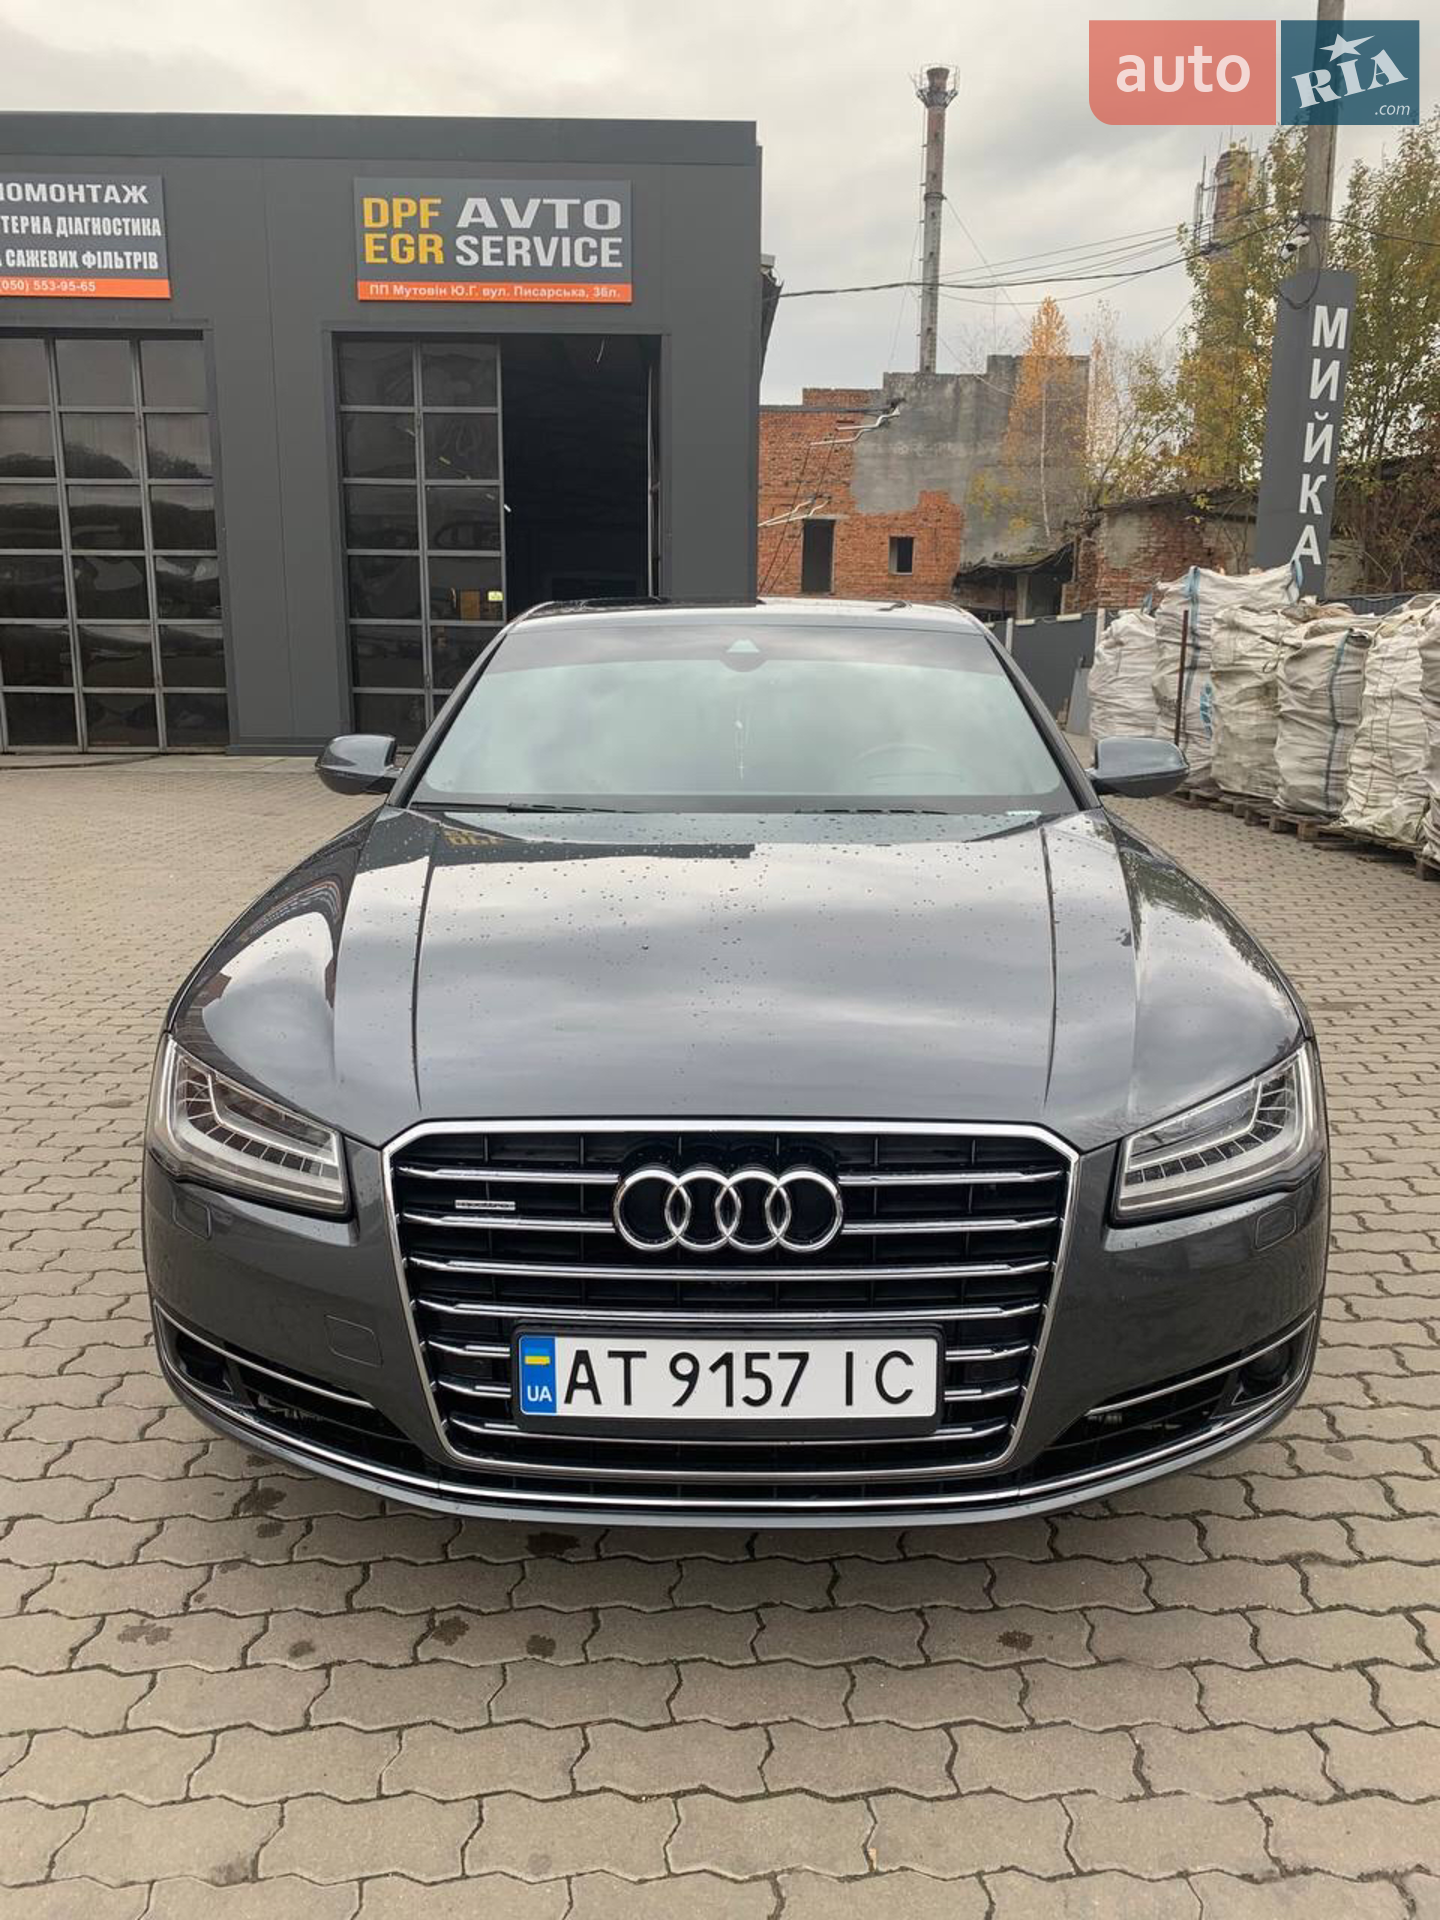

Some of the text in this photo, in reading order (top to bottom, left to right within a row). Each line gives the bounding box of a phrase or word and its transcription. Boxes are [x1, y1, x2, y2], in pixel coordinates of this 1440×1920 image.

[1, 215, 162, 238] ТЕРНА ДІАГНОСТИКА
[362, 197, 442, 229] DPF
[455, 197, 622, 230] AVTO
[5, 248, 159, 270] САЖЕВИХ ФІЛЬТРІВ
[363, 233, 445, 265] EGR
[455, 235, 624, 268] SERVICE
[33, 280, 96, 293] 553-95-65
[369, 284, 390, 295] ПП
[393, 284, 447, 298] Мутовін
[482, 286, 511, 299] вул.
[1290, 305, 1349, 565] МИЙКА
[526, 1385, 553, 1402] UA
[563, 1349, 915, 1408] AT 9157 IC
